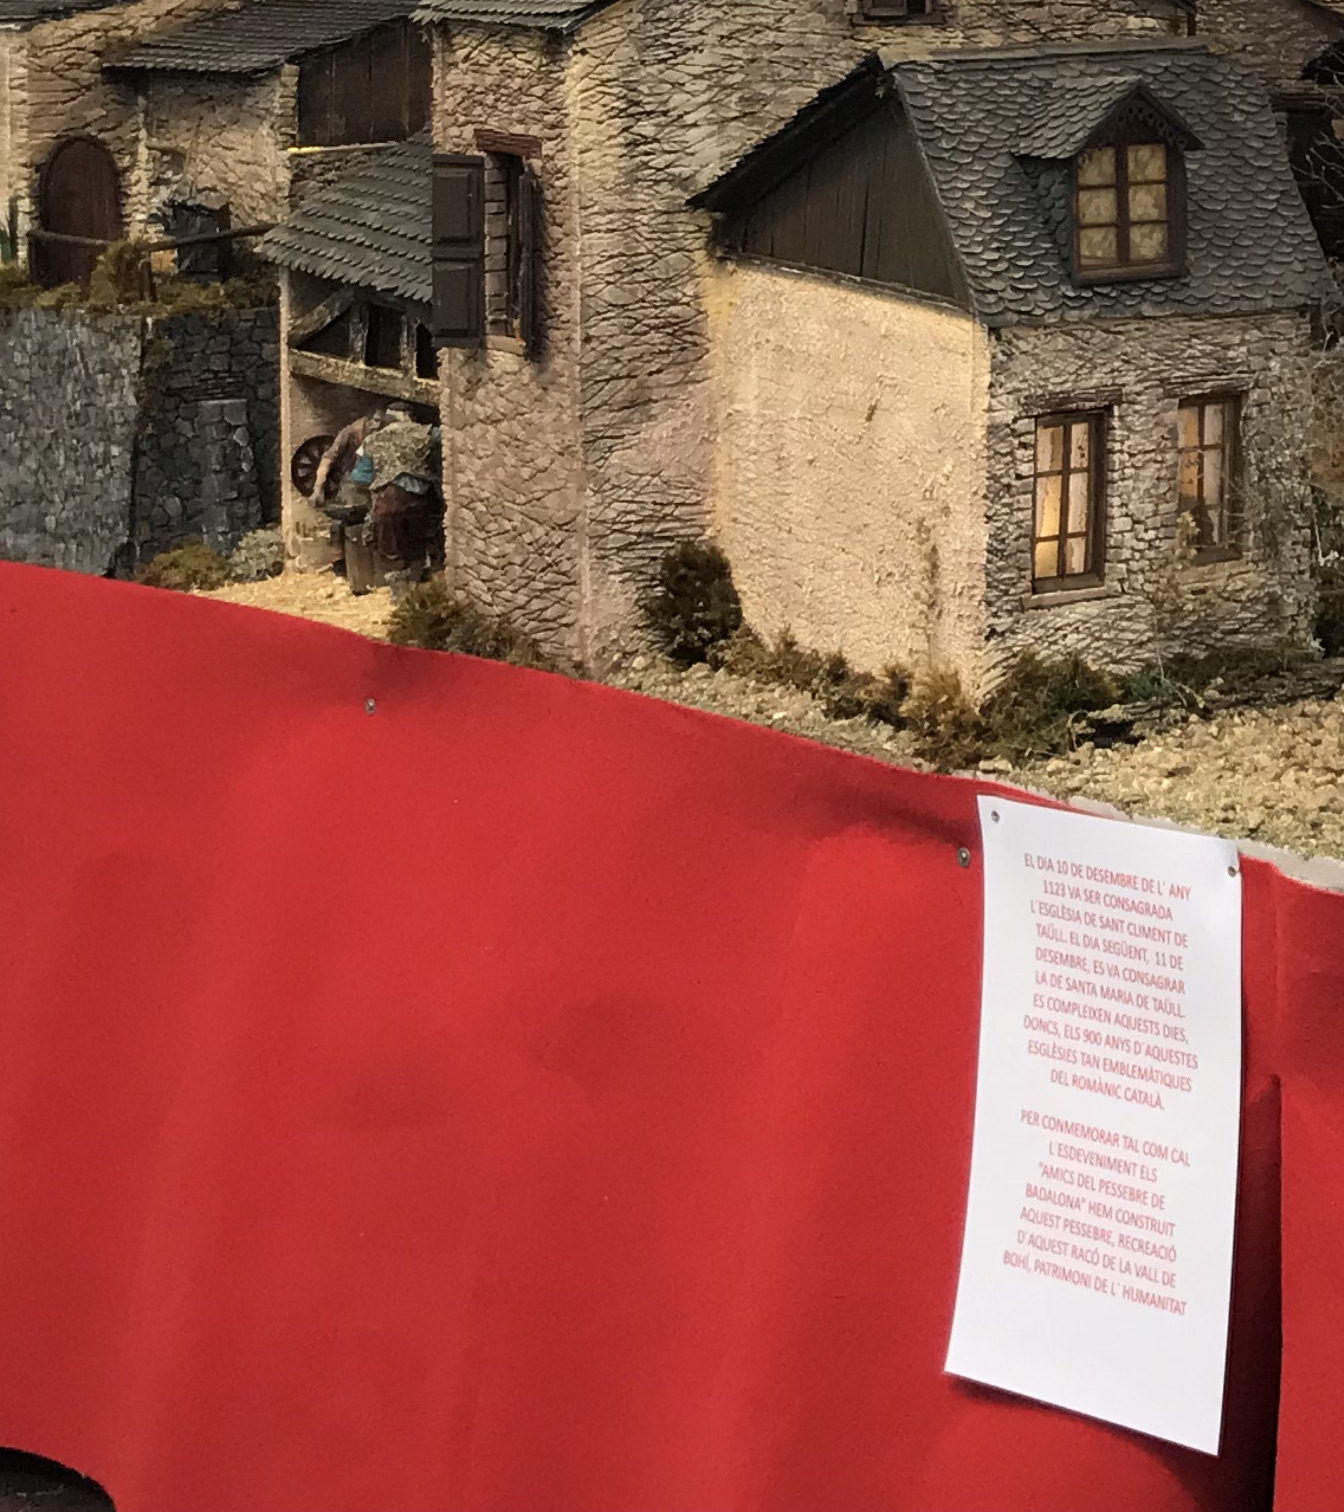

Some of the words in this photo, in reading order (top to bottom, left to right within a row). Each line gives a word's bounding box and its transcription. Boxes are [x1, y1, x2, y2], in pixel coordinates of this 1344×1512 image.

[1024, 853, 1034, 868] EL
[1037, 856, 1054, 871] DIA
[1057, 860, 1068, 874] 10
[1071, 863, 1083, 878] DE
[1086, 866, 1139, 890] DESEMBRE
[1142, 878, 1155, 894] DE
[1169, 884, 1191, 900] ANY
[1043, 880, 1065, 897] 1123
[1068, 885, 1081, 900] VA
[1083, 889, 1101, 905] SER
[1103, 893, 1173, 920] CONSAGRADA
[1084, 912, 1097, 927] DE
[1100, 915, 1124, 933] SANT
[1127, 922, 1171, 944] CLIMENT
[1174, 933, 1188, 948] DE
[1070, 932, 1080, 946] EL
[1083, 934, 1100, 951] DIA
[1156, 952, 1166, 966] 11
[1170, 955, 1183, 970] DE
[1035, 970, 1047, 985] LA
[1050, 973, 1063, 988] DE
[1065, 977, 1097, 997] SANTA
[1100, 985, 1134, 1006] MARIA
[1136, 994, 1150, 1009] DE
[1093, 960, 1104, 975] ES
[1107, 963, 1120, 978] VA
[1123, 968, 1185, 994] CONSAGRAR
[1033, 993, 1044, 1008] ES
[1047, 997, 1111, 1024] COMPLEIXEN
[1114, 1013, 1160, 1036] AQUESTS
[1064, 1024, 1080, 1040] ELS
[1083, 1029, 1101, 1043] 900
[1104, 1034, 1131, 1053] ANYS
[1051, 1069, 1069, 1086] DEL
[1080, 1052, 1100, 1070] TAN
[1021, 1109, 1039, 1126] PER
[1042, 1115, 1119, 1147] CONMEMORAR
[1122, 1135, 1139, 1153] TAL
[1143, 1140, 1168, 1160] COM
[1171, 1148, 1191, 1166] CAL
[1078, 1173, 1096, 1191] DEL
[1099, 1179, 1148, 1206] PESSEBRE
[1151, 1193, 1165, 1210] DE
[1140, 1165, 1157, 1182] ELS
[1020, 1206, 1061, 1230] AQUEST
[1088, 1201, 1112, 1220] HEM
[1115, 1208, 1176, 1236] CONSTRUIT
[1034, 1259, 1091, 1287] PATRIMONI
[1094, 1276, 1108, 1294] DE
[1122, 1285, 1187, 1316] HUMANITAT
[1102, 1254, 1116, 1270] DE
[1119, 1258, 1131, 1275] LA
[1134, 1263, 1159, 1284] VALL
[1162, 1271, 1176, 1288] DE
